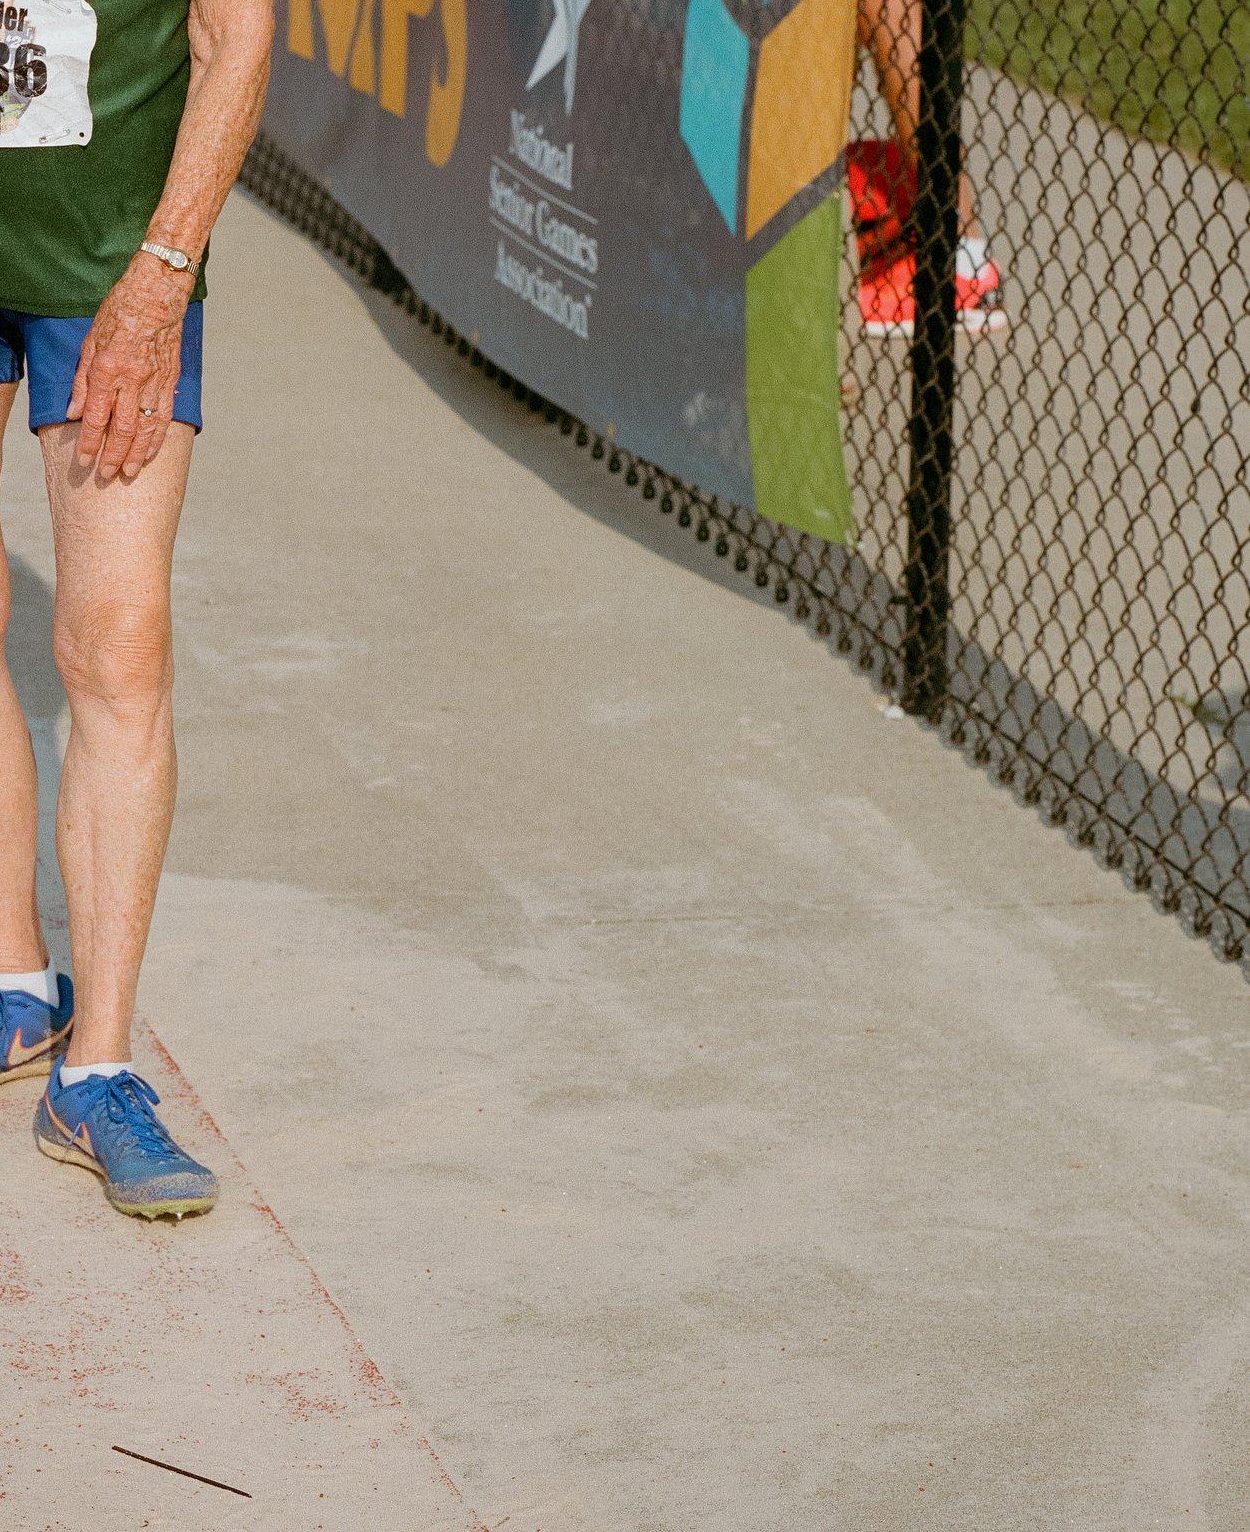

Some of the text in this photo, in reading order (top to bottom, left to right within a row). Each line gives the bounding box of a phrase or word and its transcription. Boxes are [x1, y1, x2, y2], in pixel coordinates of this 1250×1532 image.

[509, 108, 575, 192] National
[488, 164, 599, 275] Senior Games
